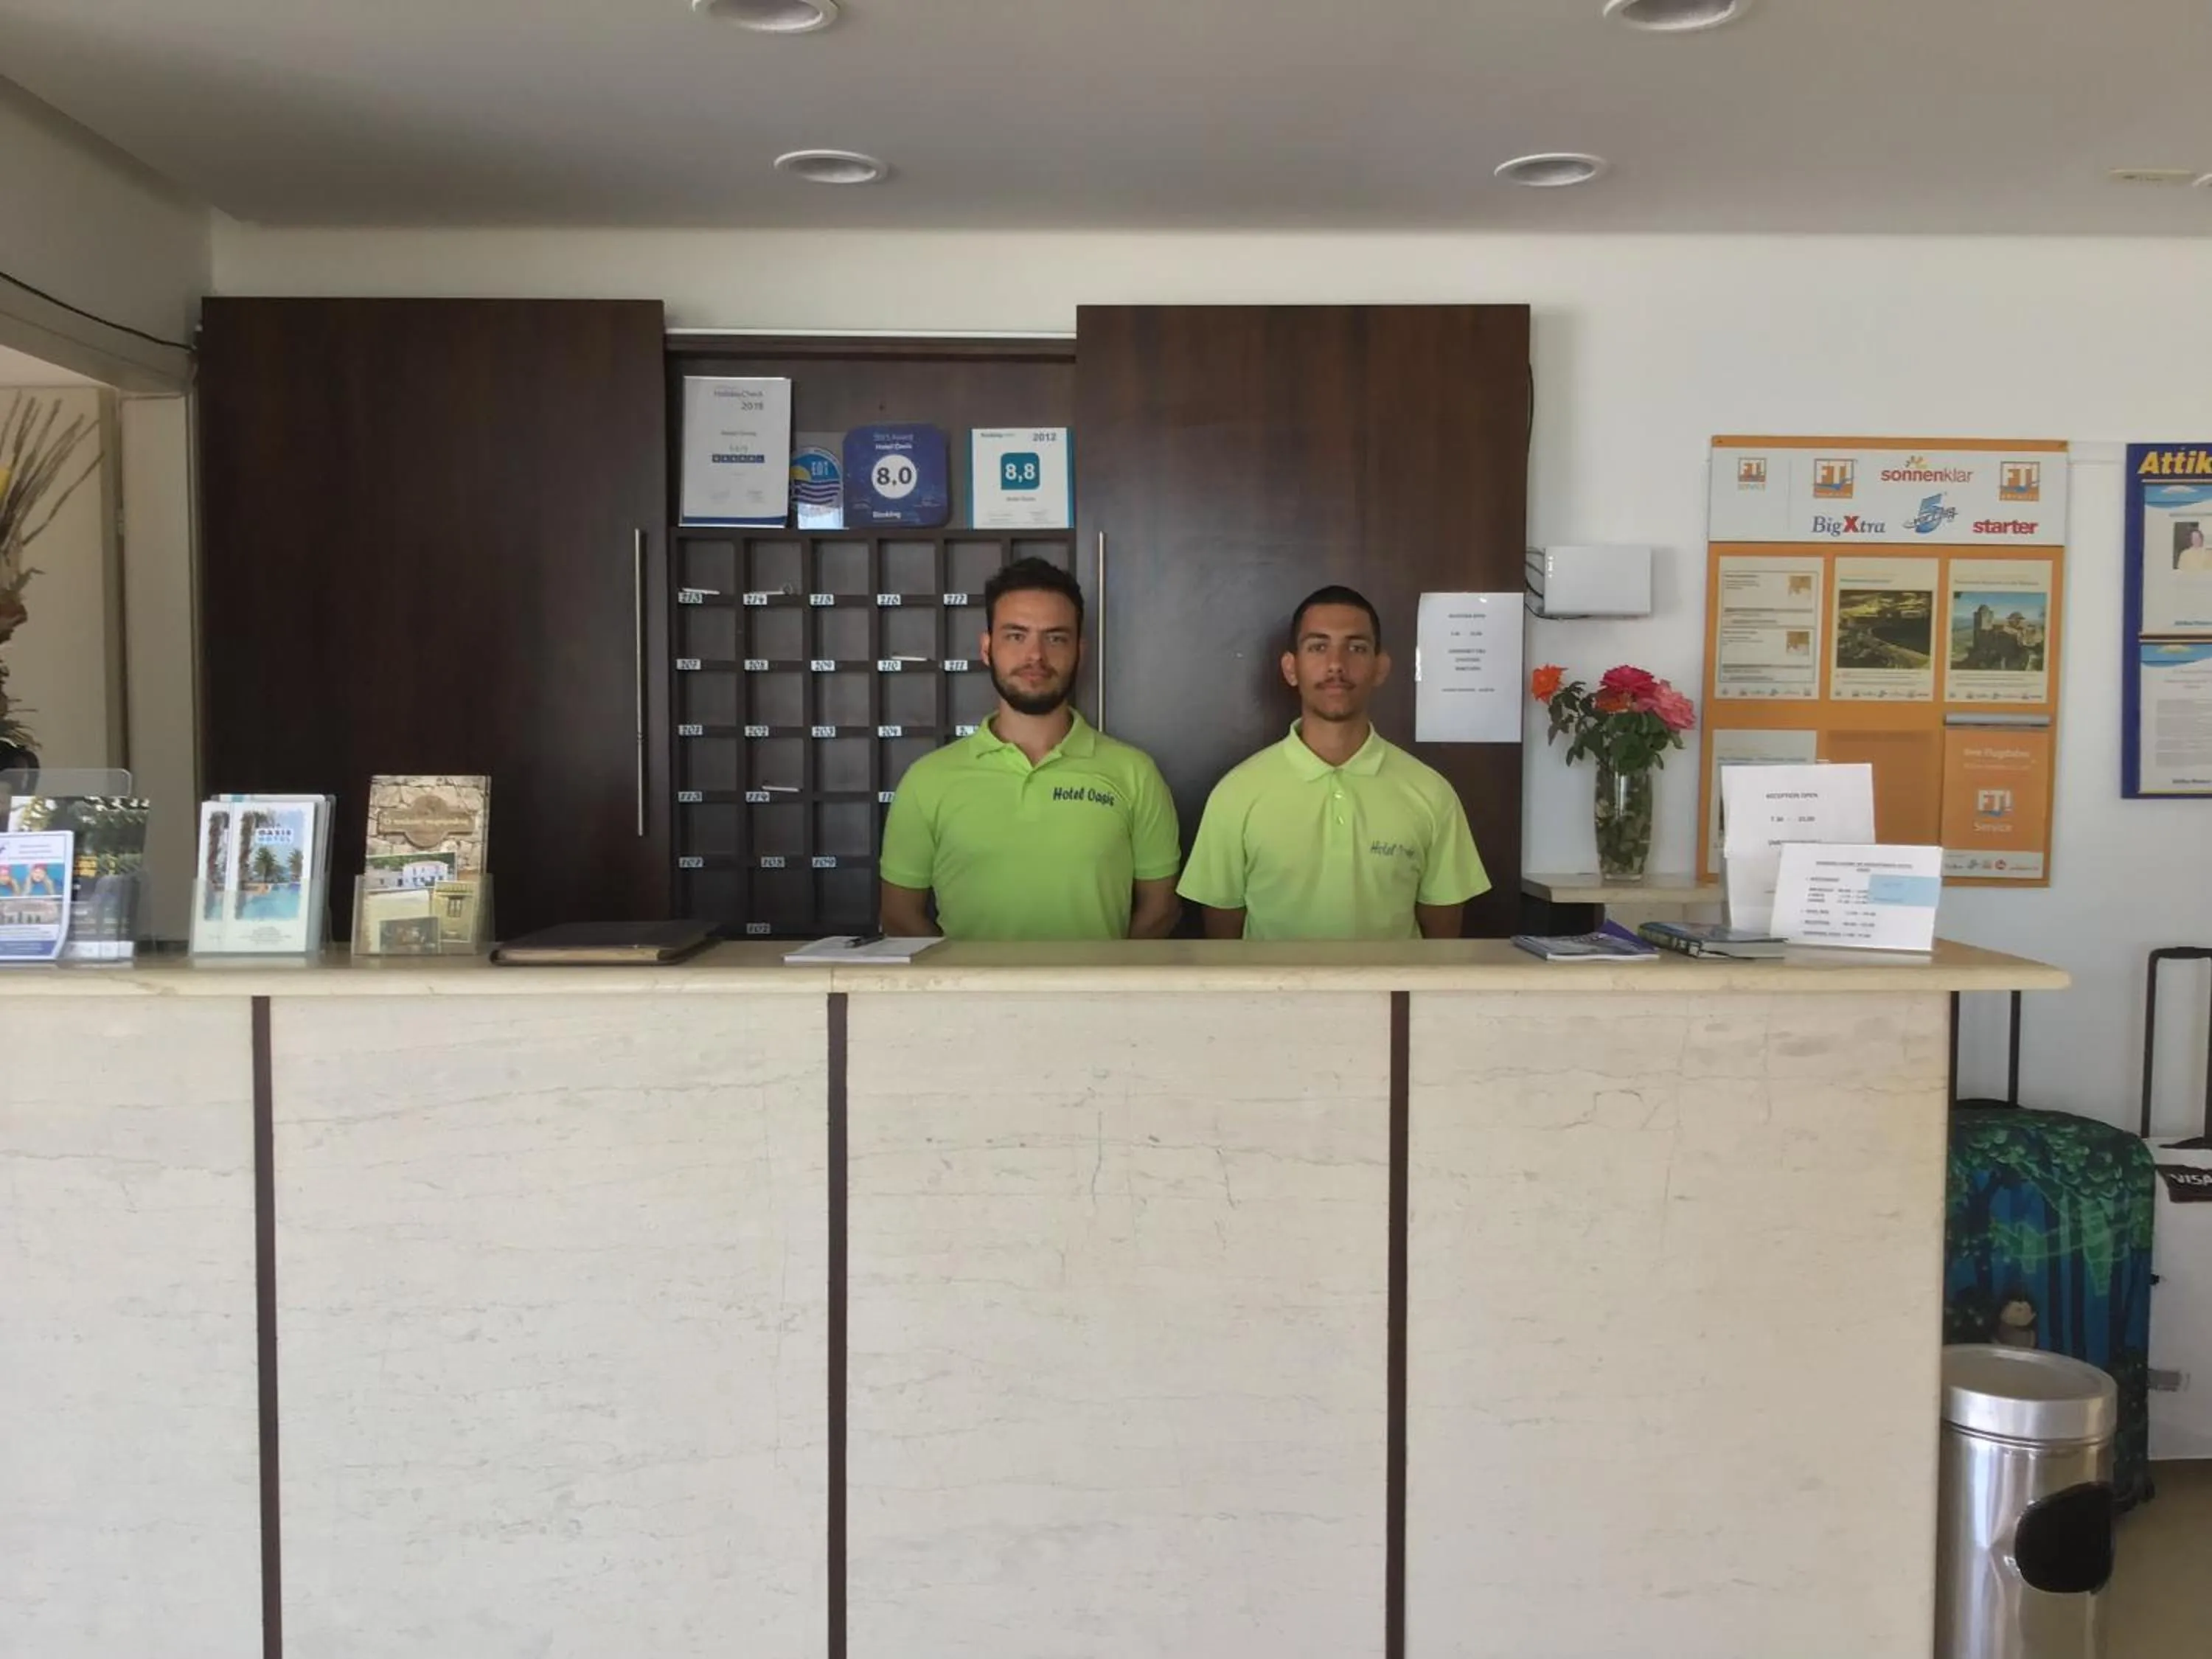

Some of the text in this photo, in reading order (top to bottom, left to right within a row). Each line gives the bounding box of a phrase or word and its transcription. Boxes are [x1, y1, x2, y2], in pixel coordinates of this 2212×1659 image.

[1033, 432, 1057, 442] 2012
[1881, 467, 1974, 483] sonnenklar
[1972, 518, 2039, 535] starter
[1053, 787, 1115, 807] Hotel Oasis
